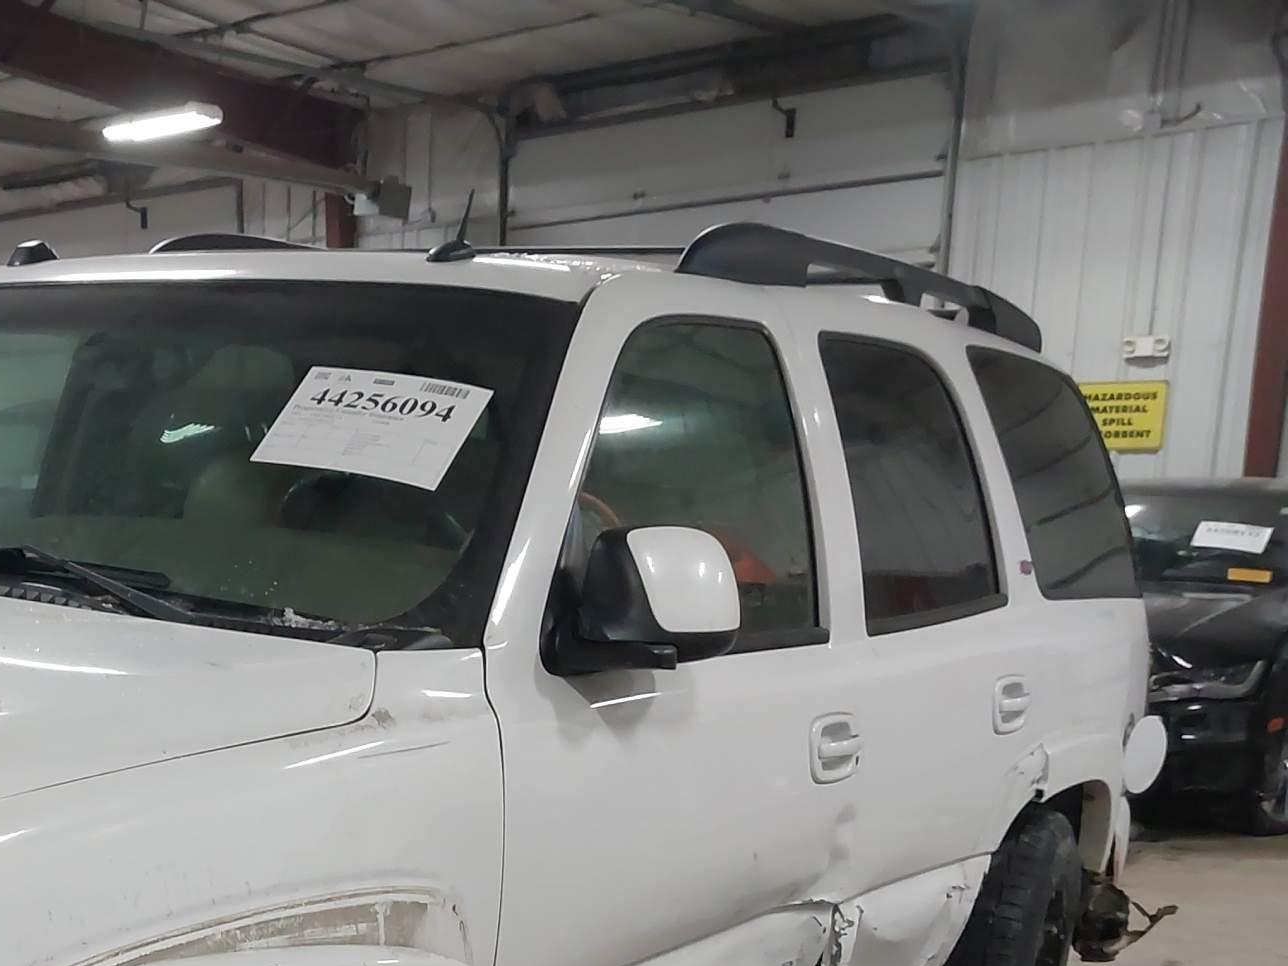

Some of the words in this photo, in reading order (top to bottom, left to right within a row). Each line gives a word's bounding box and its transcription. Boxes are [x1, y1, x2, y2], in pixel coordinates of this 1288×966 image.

[1083, 392, 1158, 401] HAZARDOUS
[311, 388, 456, 422] 44256094
[1090, 404, 1148, 414] MATERIAL
[1102, 418, 1133, 426] SPILL
[1100, 430, 1151, 439] ORBENT
